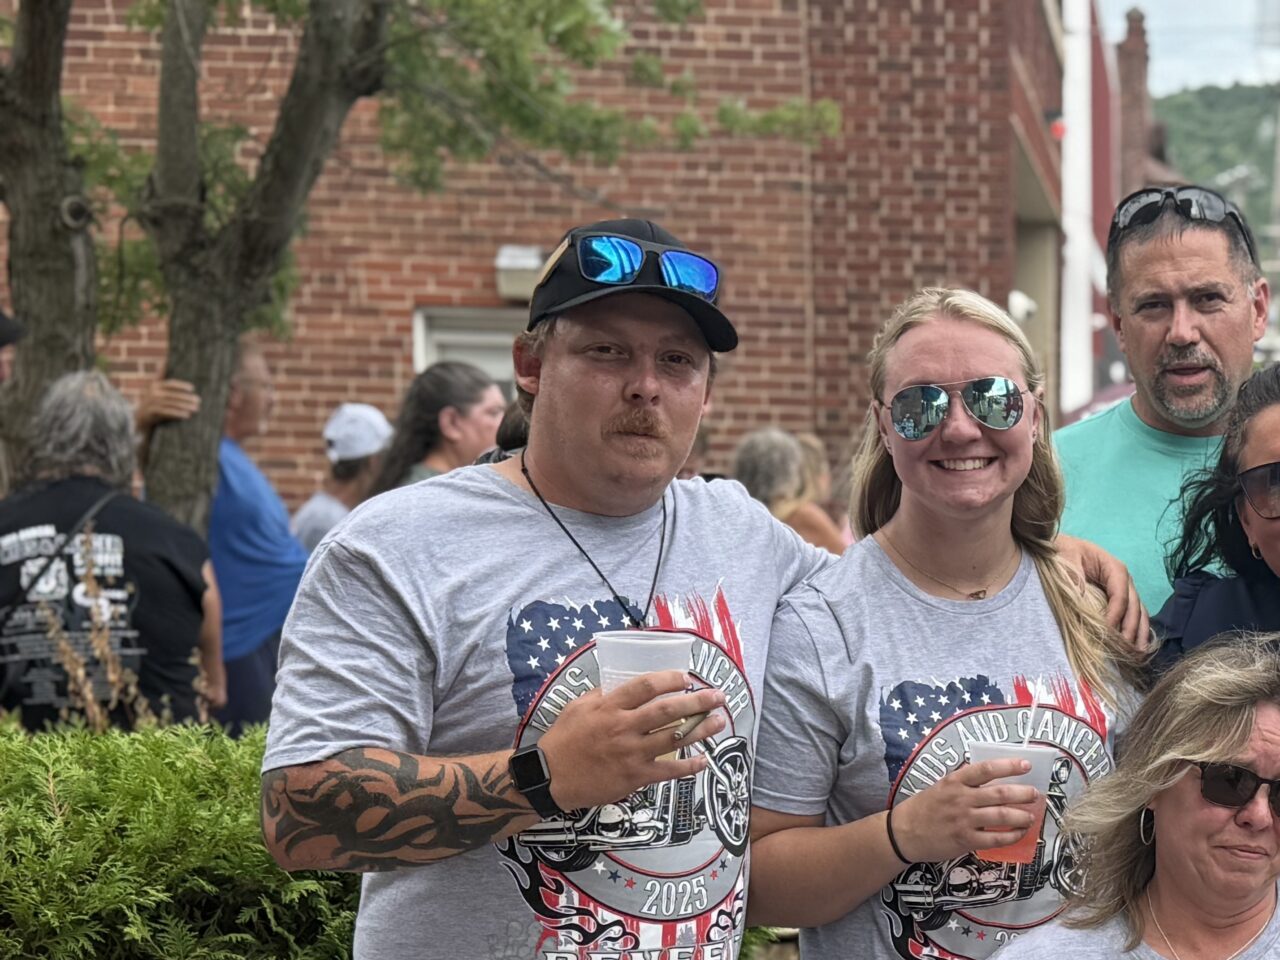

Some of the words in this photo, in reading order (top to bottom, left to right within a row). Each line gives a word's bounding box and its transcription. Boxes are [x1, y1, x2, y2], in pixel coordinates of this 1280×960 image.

[900, 738, 959, 797] KIDS
[1017, 709, 1111, 780] CANCER
[640, 875, 708, 917] 2025
